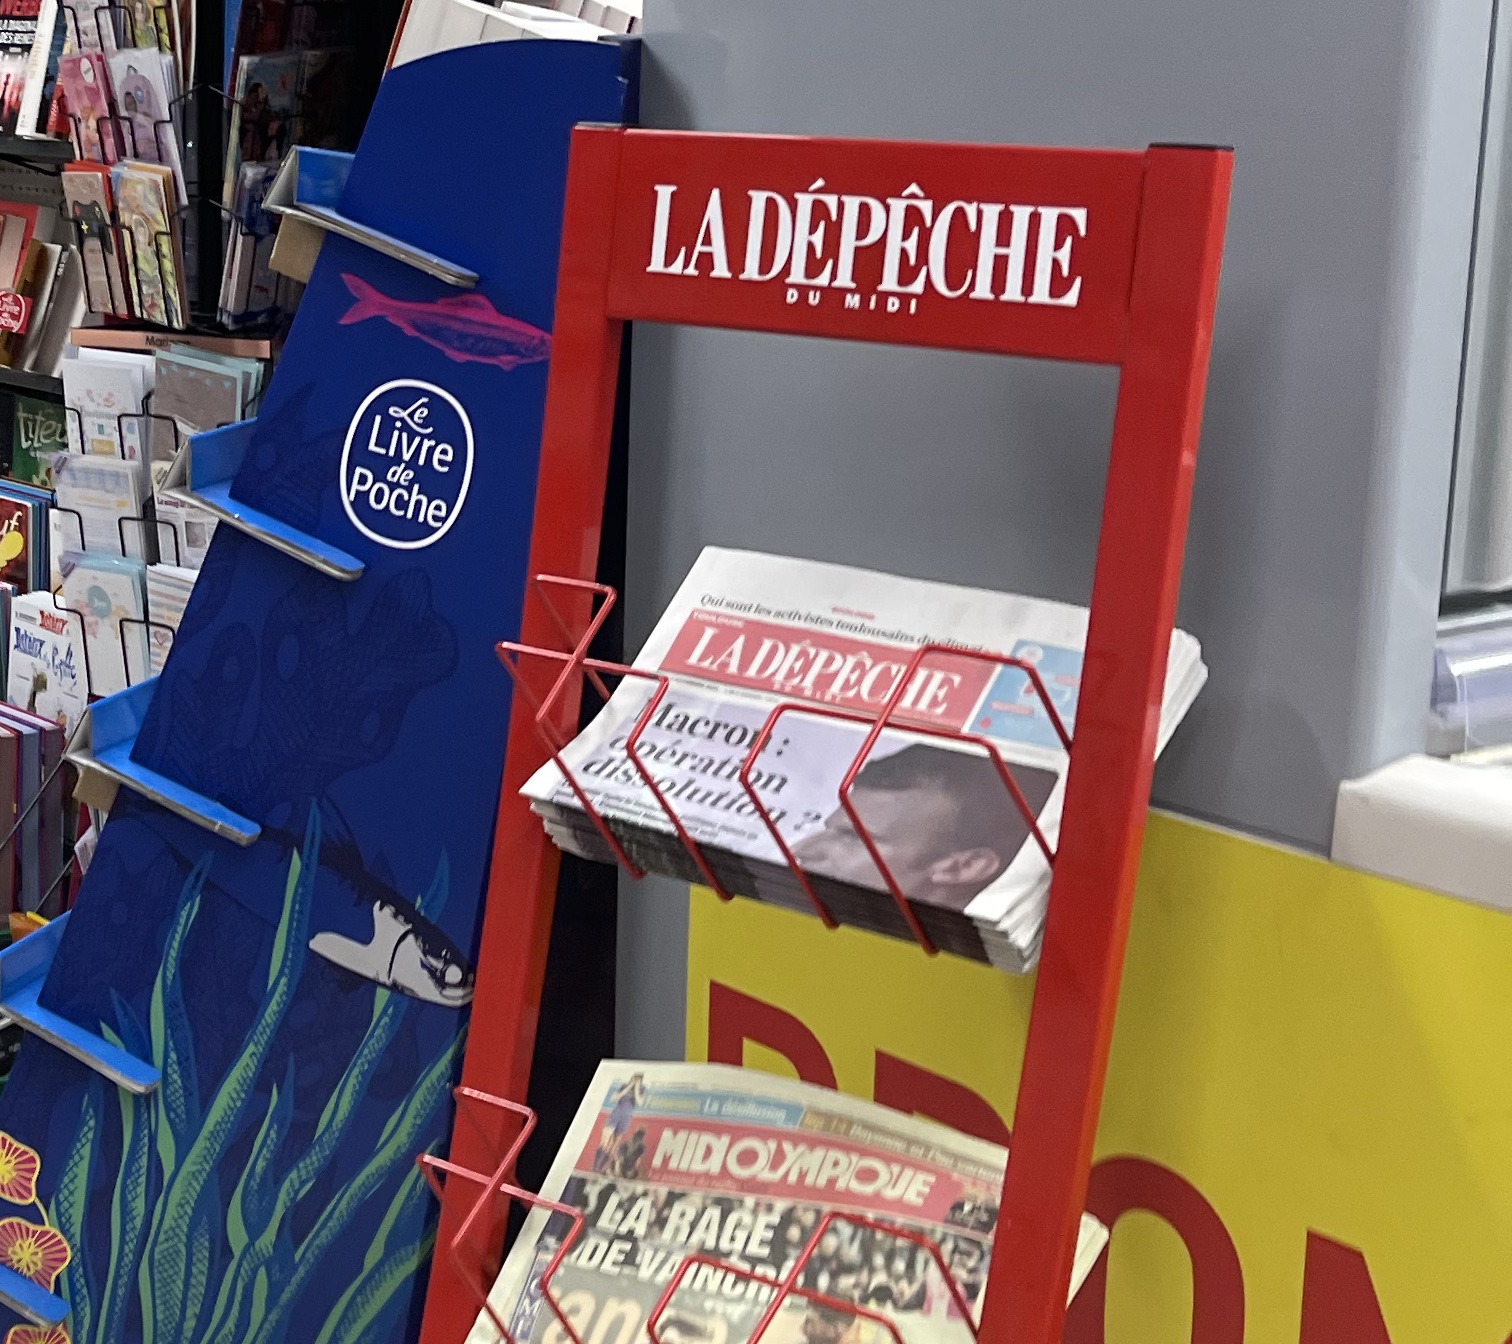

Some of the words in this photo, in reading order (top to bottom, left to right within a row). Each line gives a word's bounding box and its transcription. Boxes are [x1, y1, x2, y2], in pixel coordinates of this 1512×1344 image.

[738, 177, 1088, 308] DÉPÊCHE
[785, 287, 822, 307] DU
[844, 291, 918, 316] MIDI
[16, 402, 69, 450] titeu
[367, 414, 455, 473] Livre
[388, 397, 434, 434] Le
[348, 466, 448, 529] Poche
[386, 463, 415, 487] de
[582, 756, 787, 826] dissolution
[608, 733, 789, 794] opération
[651, 1127, 733, 1177] MIDI
[726, 1137, 937, 1208] OLYMPIQUE
[595, 1192, 654, 1239] LA
[660, 1203, 782, 1258] RAGE
